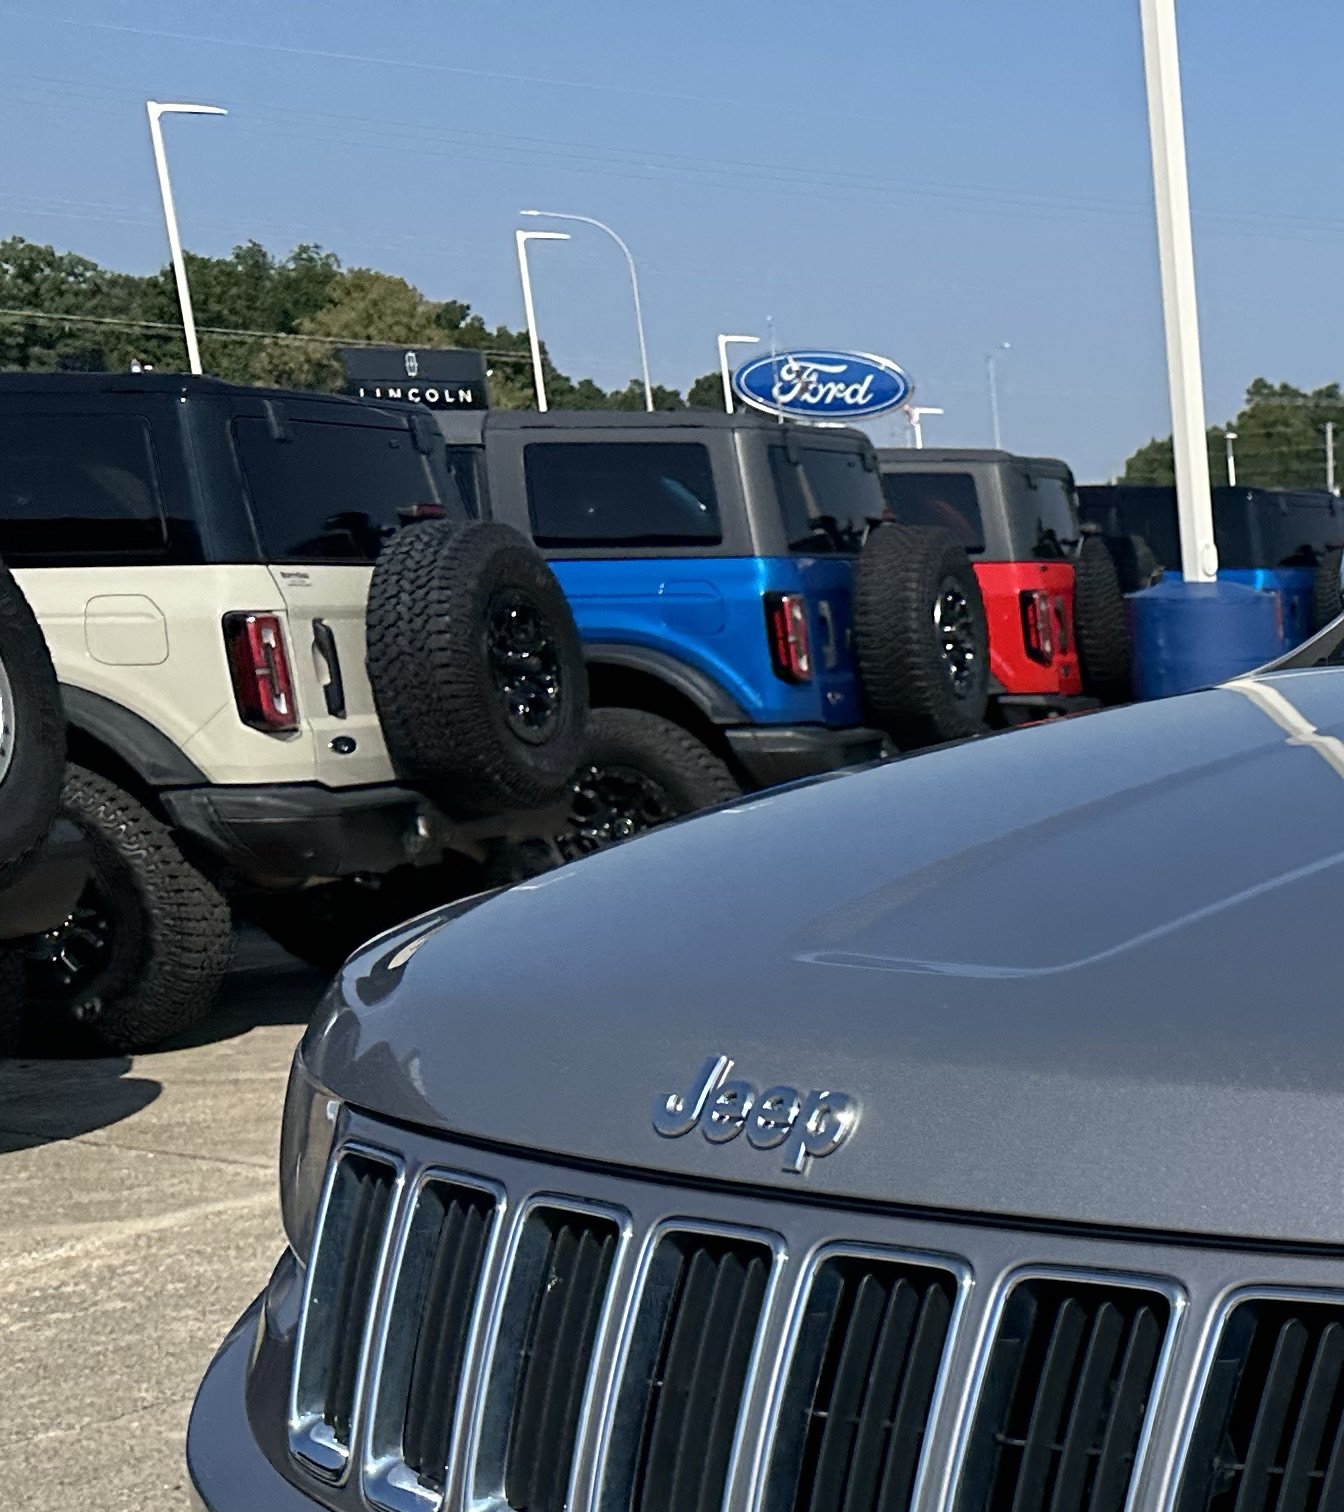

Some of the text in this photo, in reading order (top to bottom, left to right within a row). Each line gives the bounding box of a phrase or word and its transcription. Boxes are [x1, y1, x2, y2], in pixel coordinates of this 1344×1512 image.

[359, 387, 473, 403] LINCOLN
[771, 360, 876, 405] Ford
[651, 1052, 861, 1175] Jeep
